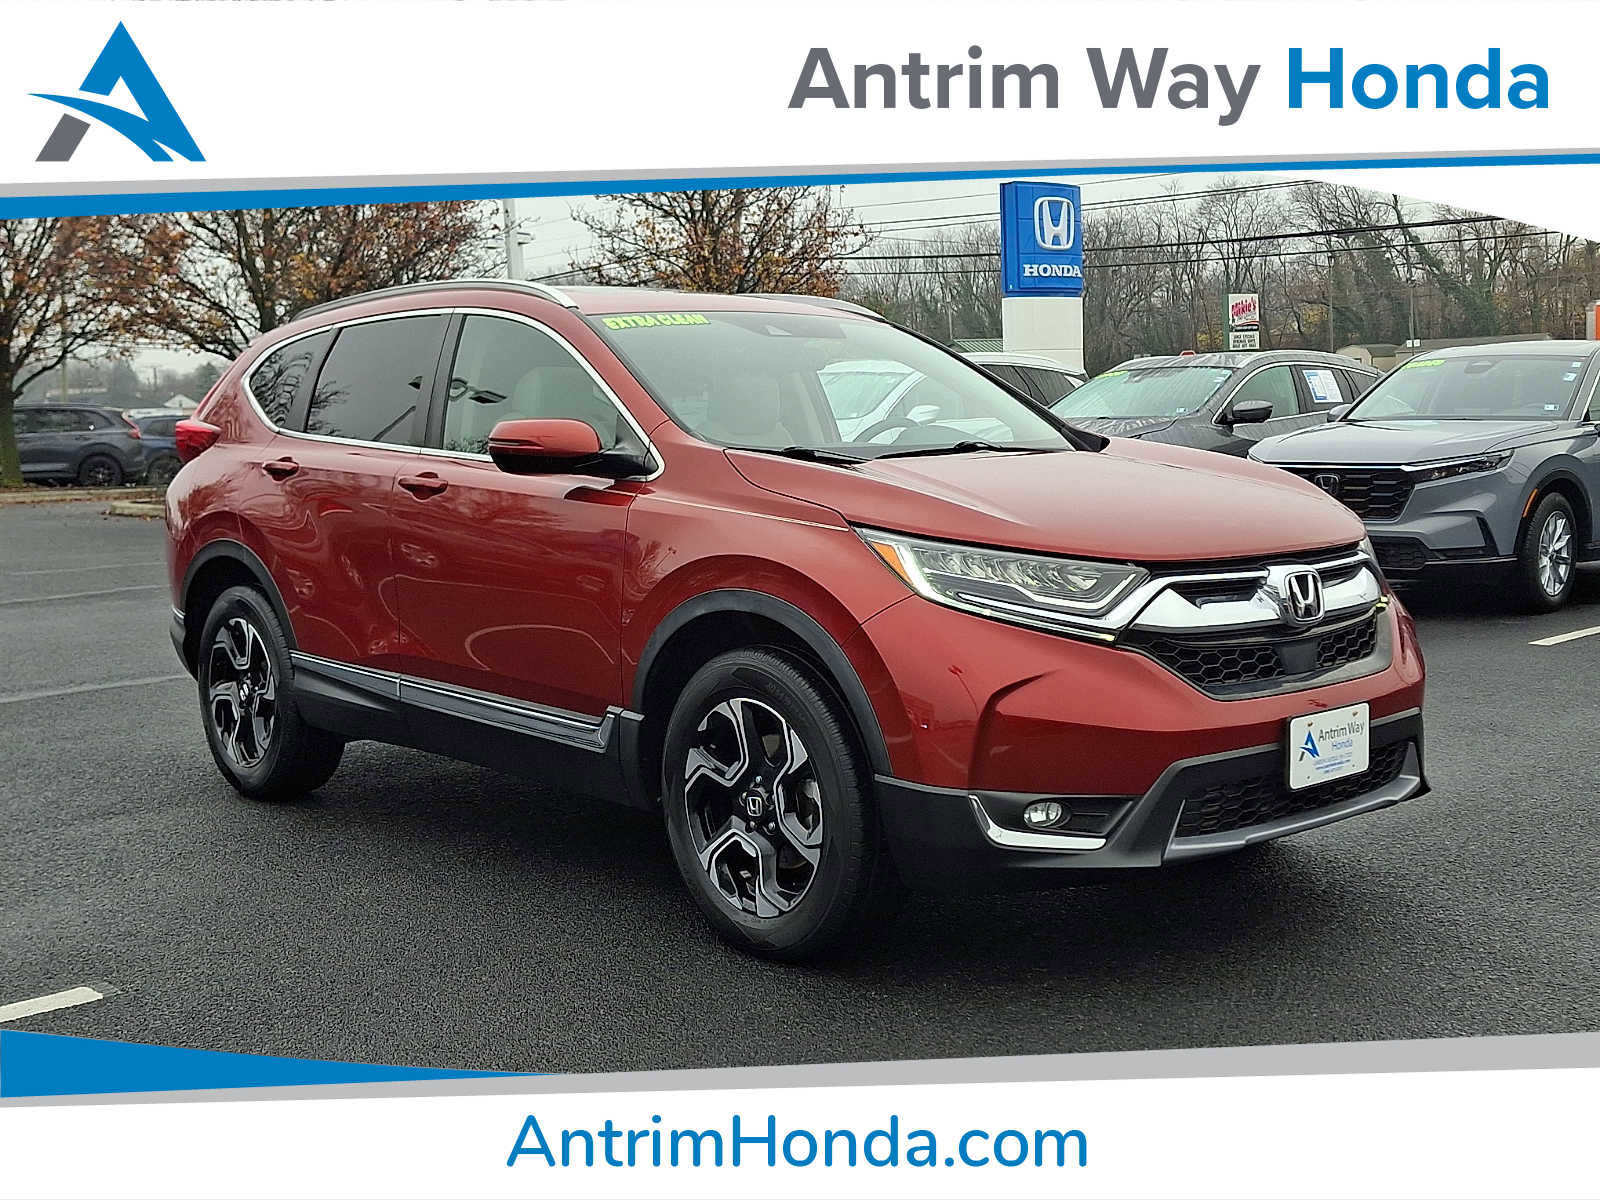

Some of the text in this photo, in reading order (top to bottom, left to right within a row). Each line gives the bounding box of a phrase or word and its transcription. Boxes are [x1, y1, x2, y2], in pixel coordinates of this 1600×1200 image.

[1022, 263, 1083, 278] HONDA
[602, 313, 711, 330] EXTRA CLEAN
[1318, 720, 1365, 742] Antrim Way
